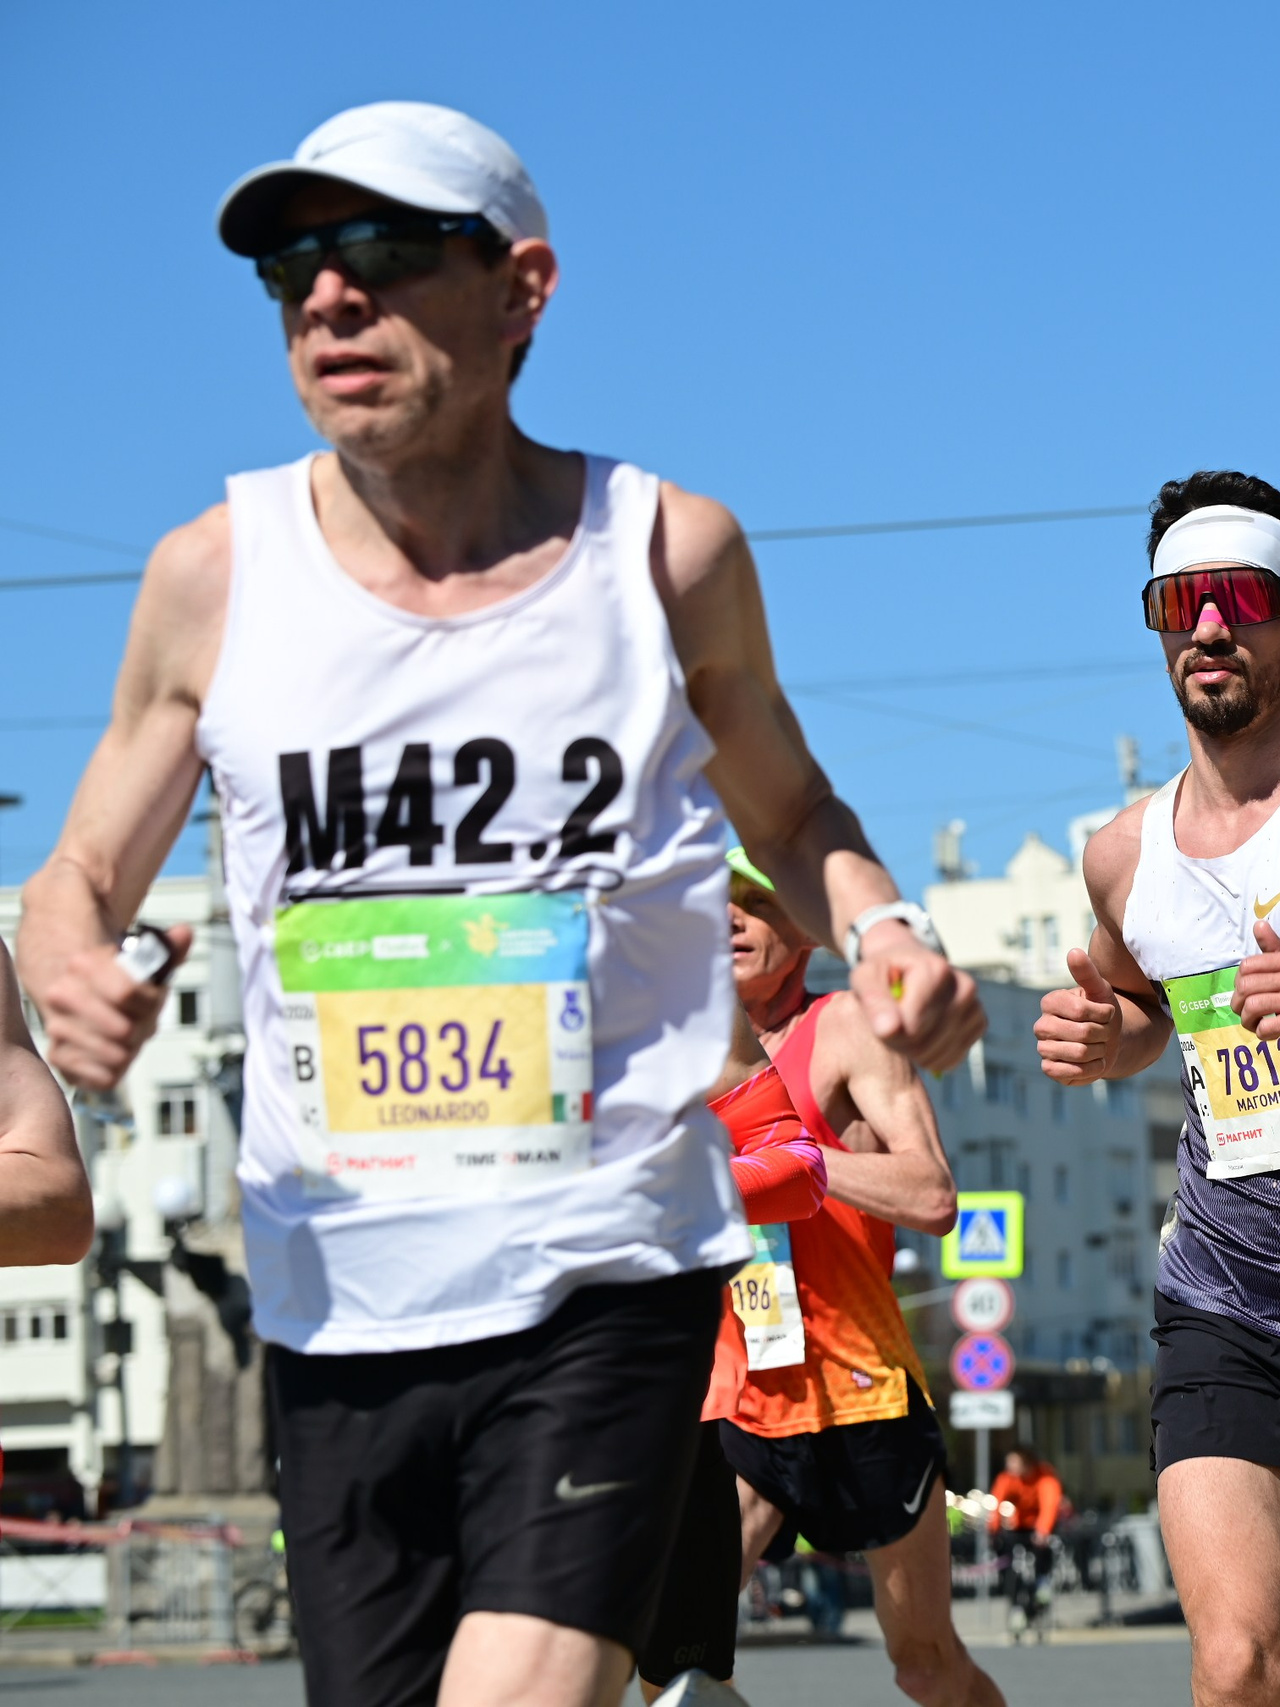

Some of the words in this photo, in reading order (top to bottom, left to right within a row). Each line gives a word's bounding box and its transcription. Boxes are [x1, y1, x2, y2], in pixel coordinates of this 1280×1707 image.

[278, 736, 625, 877] M42.2
[1188, 999, 1210, 1011] СБЕР
[357, 1019, 514, 1097] 5834
[378, 1099, 490, 1127] LEONARDO
[1225, 1128, 1264, 1144] МАГНИТ
[733, 1278, 772, 1311] 186
